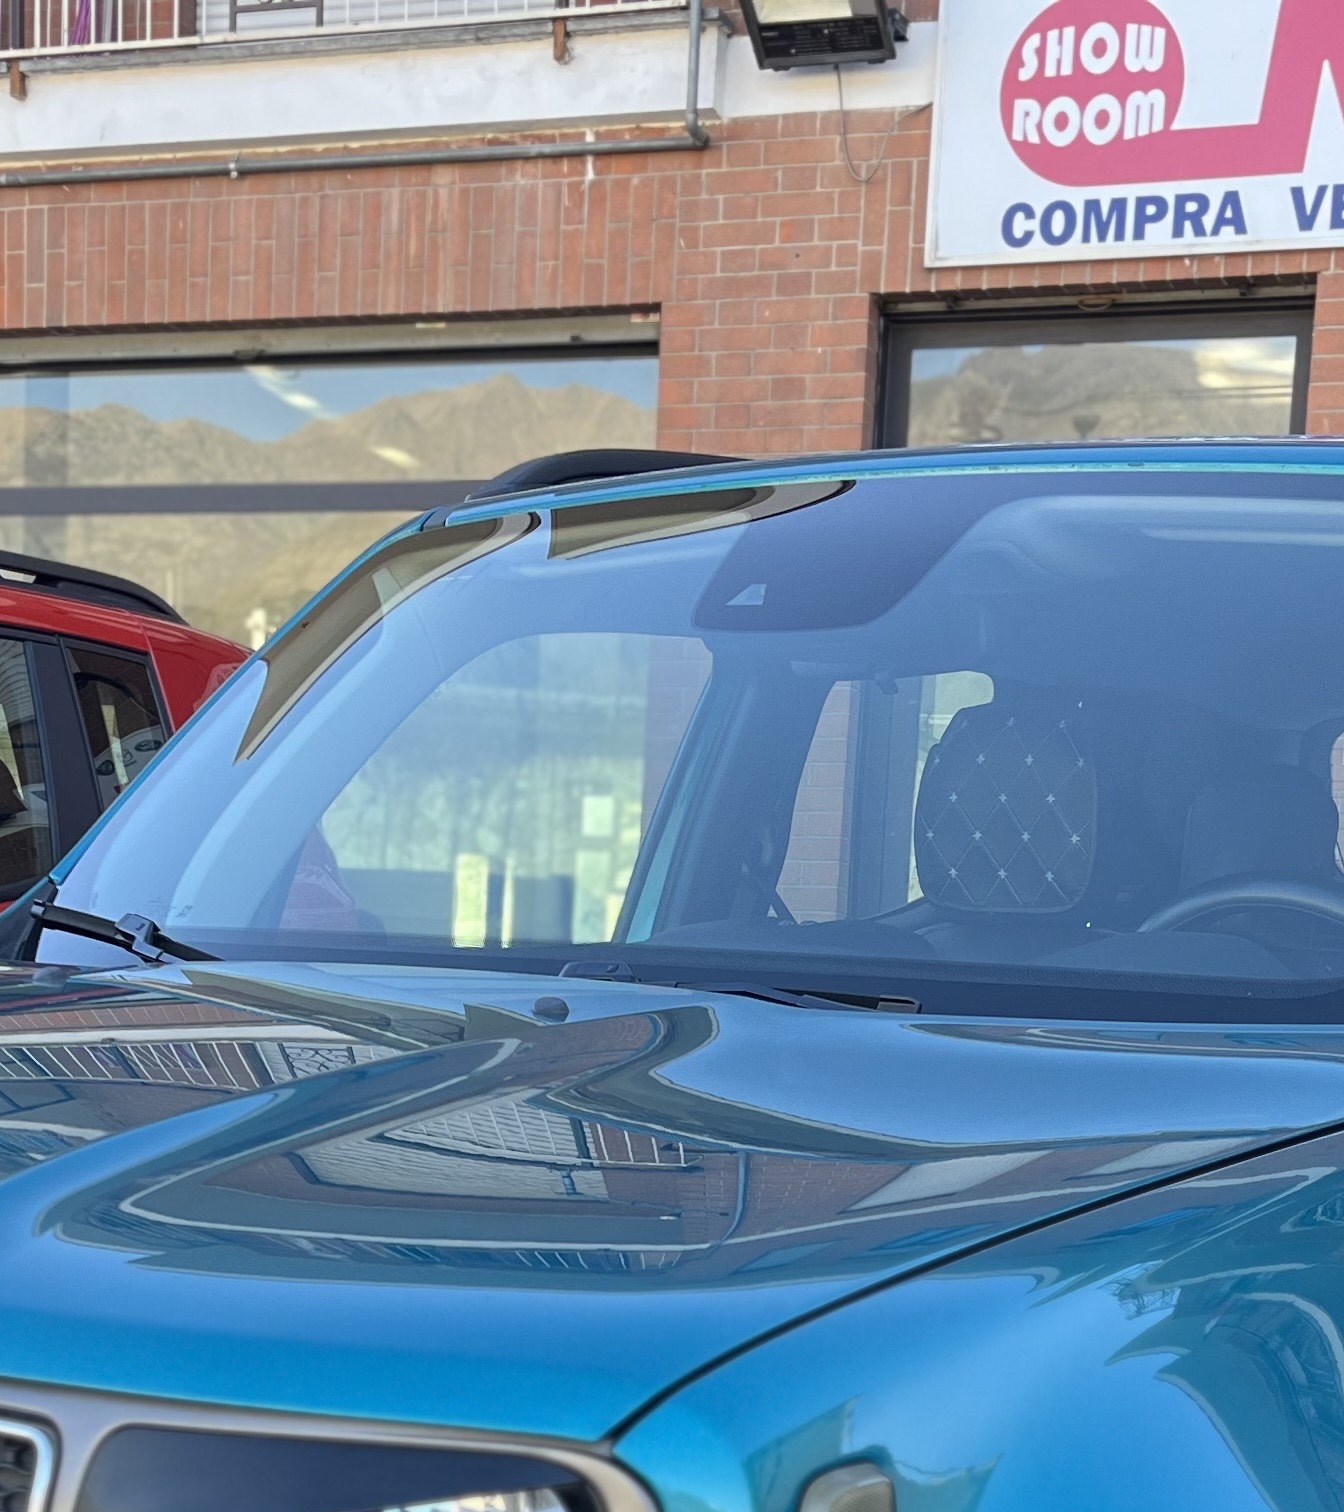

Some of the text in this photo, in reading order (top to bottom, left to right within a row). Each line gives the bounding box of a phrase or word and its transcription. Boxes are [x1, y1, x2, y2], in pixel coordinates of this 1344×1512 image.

[1017, 21, 1167, 82] SHOW
[1011, 88, 1166, 147] ROOM
[1001, 190, 1248, 248] COMPRA
